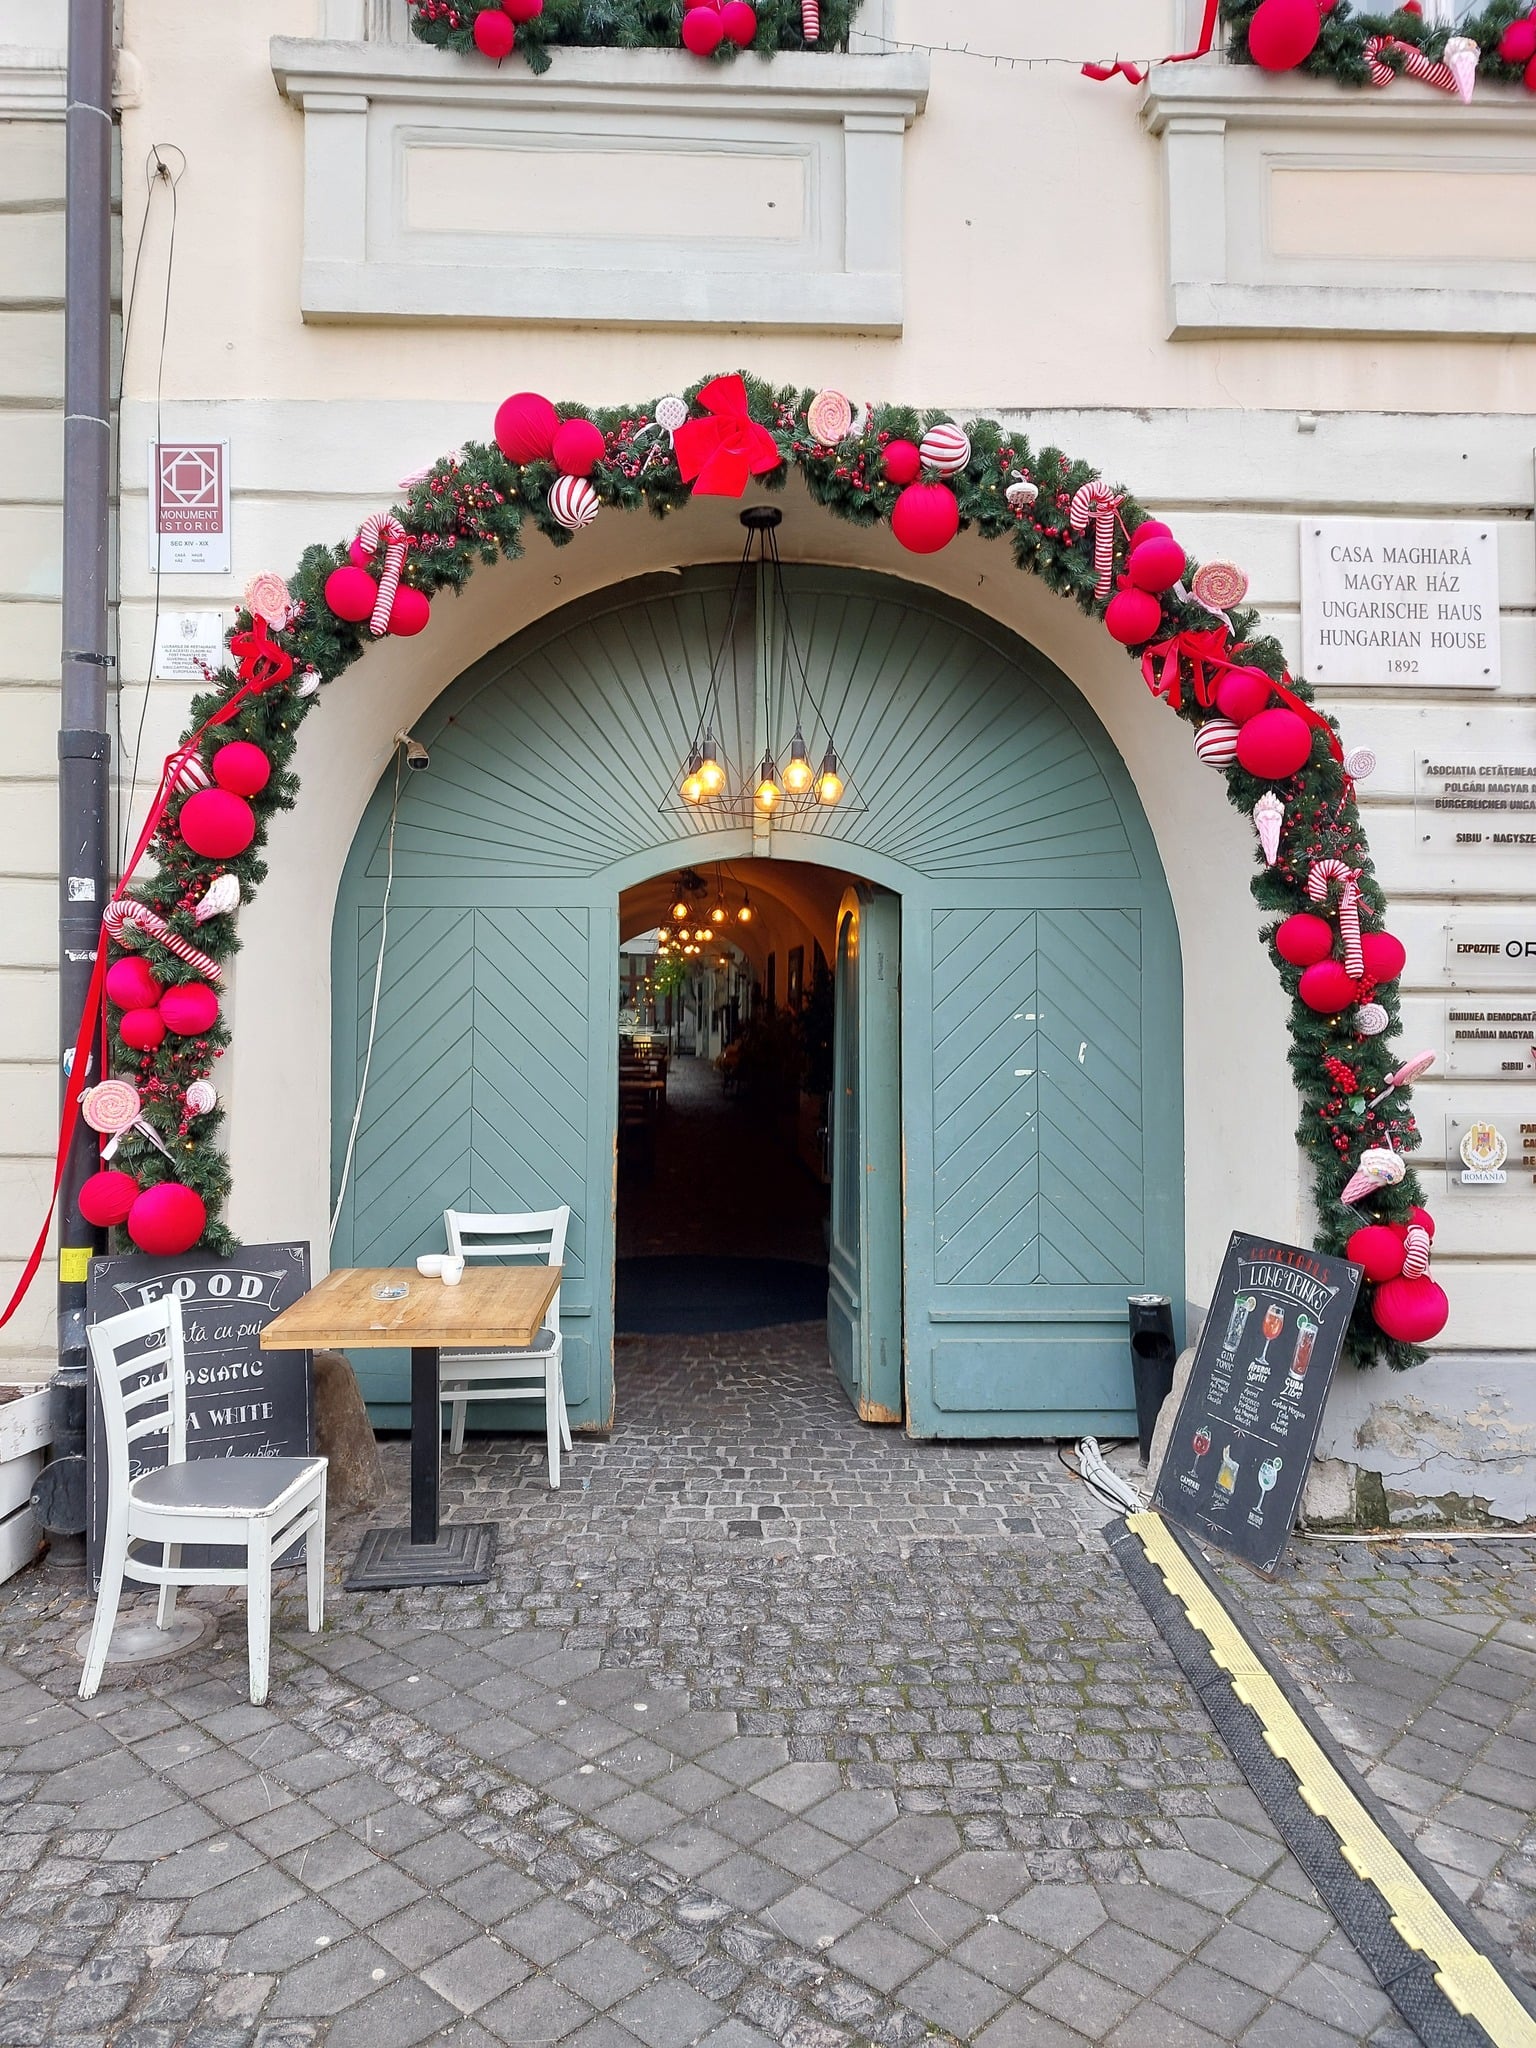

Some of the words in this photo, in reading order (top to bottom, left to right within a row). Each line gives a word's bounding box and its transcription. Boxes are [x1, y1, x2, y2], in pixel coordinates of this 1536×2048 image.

[160, 510, 218, 519] MONUMENT
[160, 522, 219, 531] ISTORIC
[1330, 546, 1374, 563] CASA
[1344, 574, 1418, 592] MAGYAR
[1426, 571, 1460, 593] HÁZ
[1322, 601, 1429, 620] UNGARISCHE
[1438, 604, 1482, 621] HAUS
[1320, 629, 1421, 648] HUNGARIAN
[1431, 631, 1487, 649] HOUSE
[1387, 660, 1419, 673] 1892
[1444, 781, 1486, 793] POLGÁRI
[1488, 783, 1529, 793] MAGYAR
[1435, 796, 1507, 809] BÜRGERLICHER
[1509, 800, 1536, 810] UNGA
[1456, 833, 1482, 843] SIBIU
[1457, 943, 1501, 955] EXPOZIȚIE
[1449, 1012, 1485, 1021] UNIUNEA
[1455, 1028, 1497, 1039] ROMÁNIAI
[1498, 1030, 1534, 1040] MAGYAR
[1501, 1062, 1524, 1071] SIBIU
[1523, 1139, 1536, 1148] CA
[1464, 1173, 1505, 1181] ROMANIA
[138, 1274, 264, 1306] FOOD
[1250, 1266, 1284, 1288] LONG
[1285, 1272, 1328, 1310] DRINKS
[213, 1325, 234, 1341] cu
[236, 1320, 263, 1343] pui
[1220, 1350, 1236, 1362] GIN
[1215, 1358, 1235, 1372] TONIC
[1247, 1361, 1272, 1375] APEROL
[185, 1360, 264, 1386] ASIATIC
[1246, 1372, 1268, 1384] Spritz
[1284, 1377, 1304, 1392] CUBA
[1279, 1385, 1303, 1399] Libre
[209, 1401, 274, 1427] WHITE
[1179, 1474, 1201, 1491] CAMPARI
[1179, 1483, 1197, 1498] TONIC
[1248, 1511, 1264, 1526] HUGO
